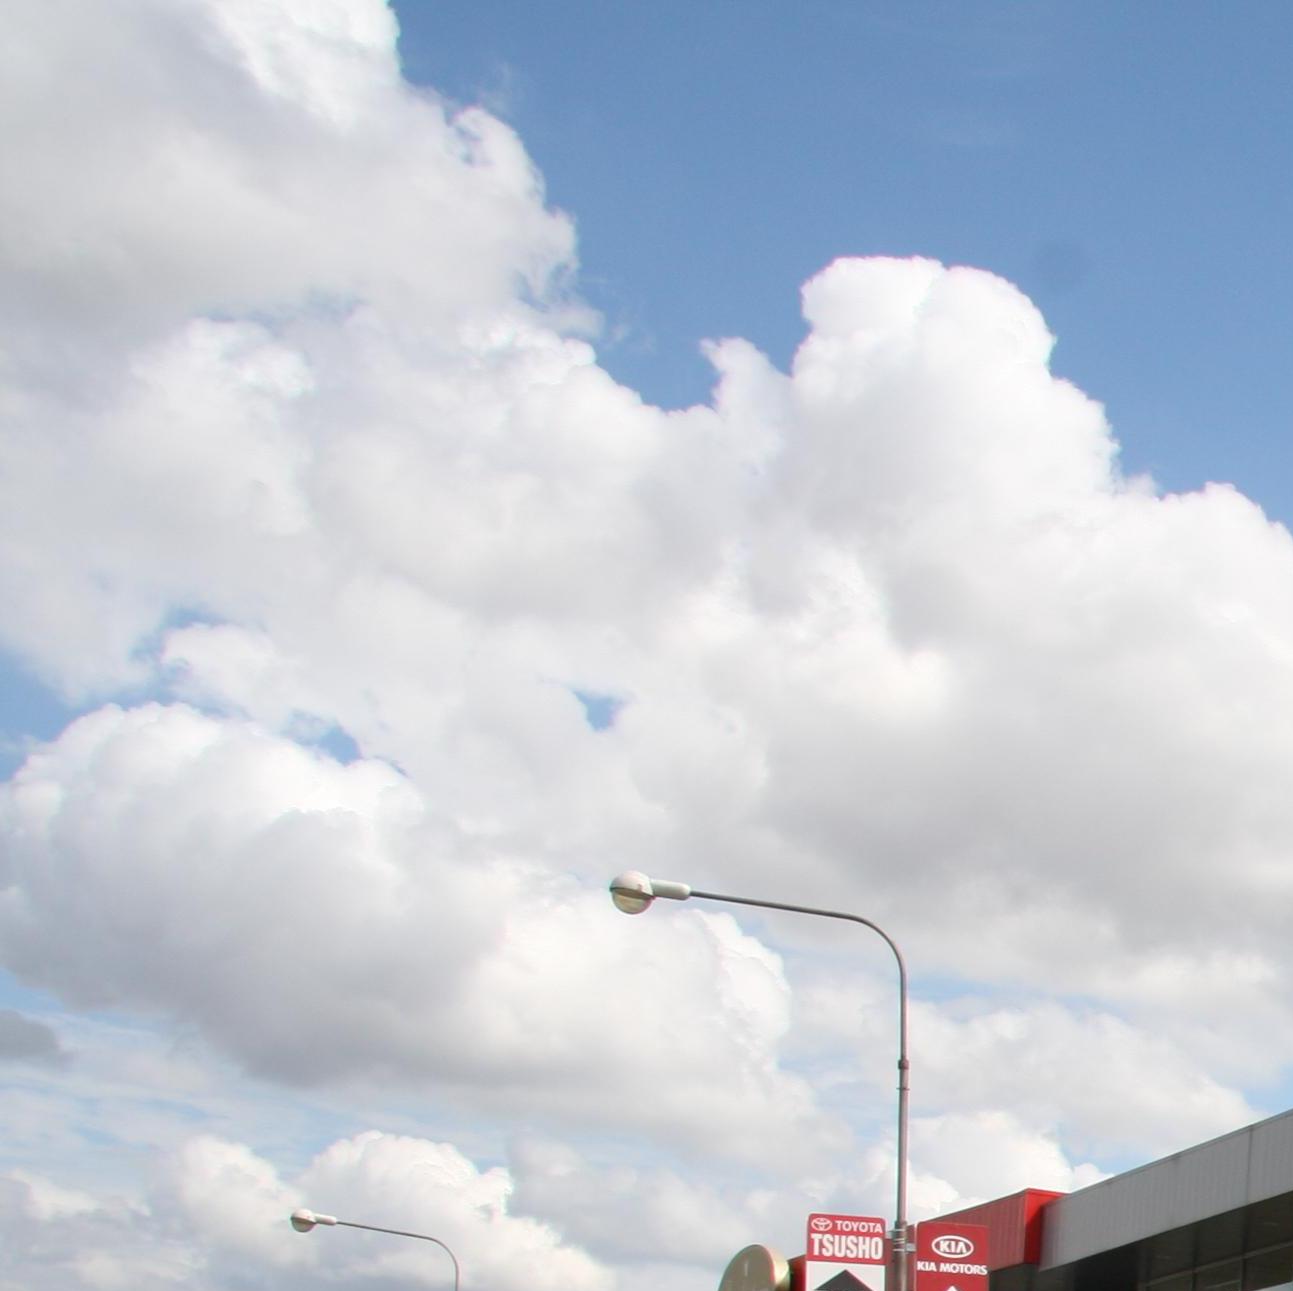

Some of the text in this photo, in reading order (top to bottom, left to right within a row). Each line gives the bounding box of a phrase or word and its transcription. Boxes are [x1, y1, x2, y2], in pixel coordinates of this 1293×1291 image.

[834, 1220, 883, 1234] TOYOTA
[810, 1233, 884, 1260] TSUSHO
[939, 1239, 968, 1254] KIA
[916, 1260, 988, 1276] KIA MOTORS
